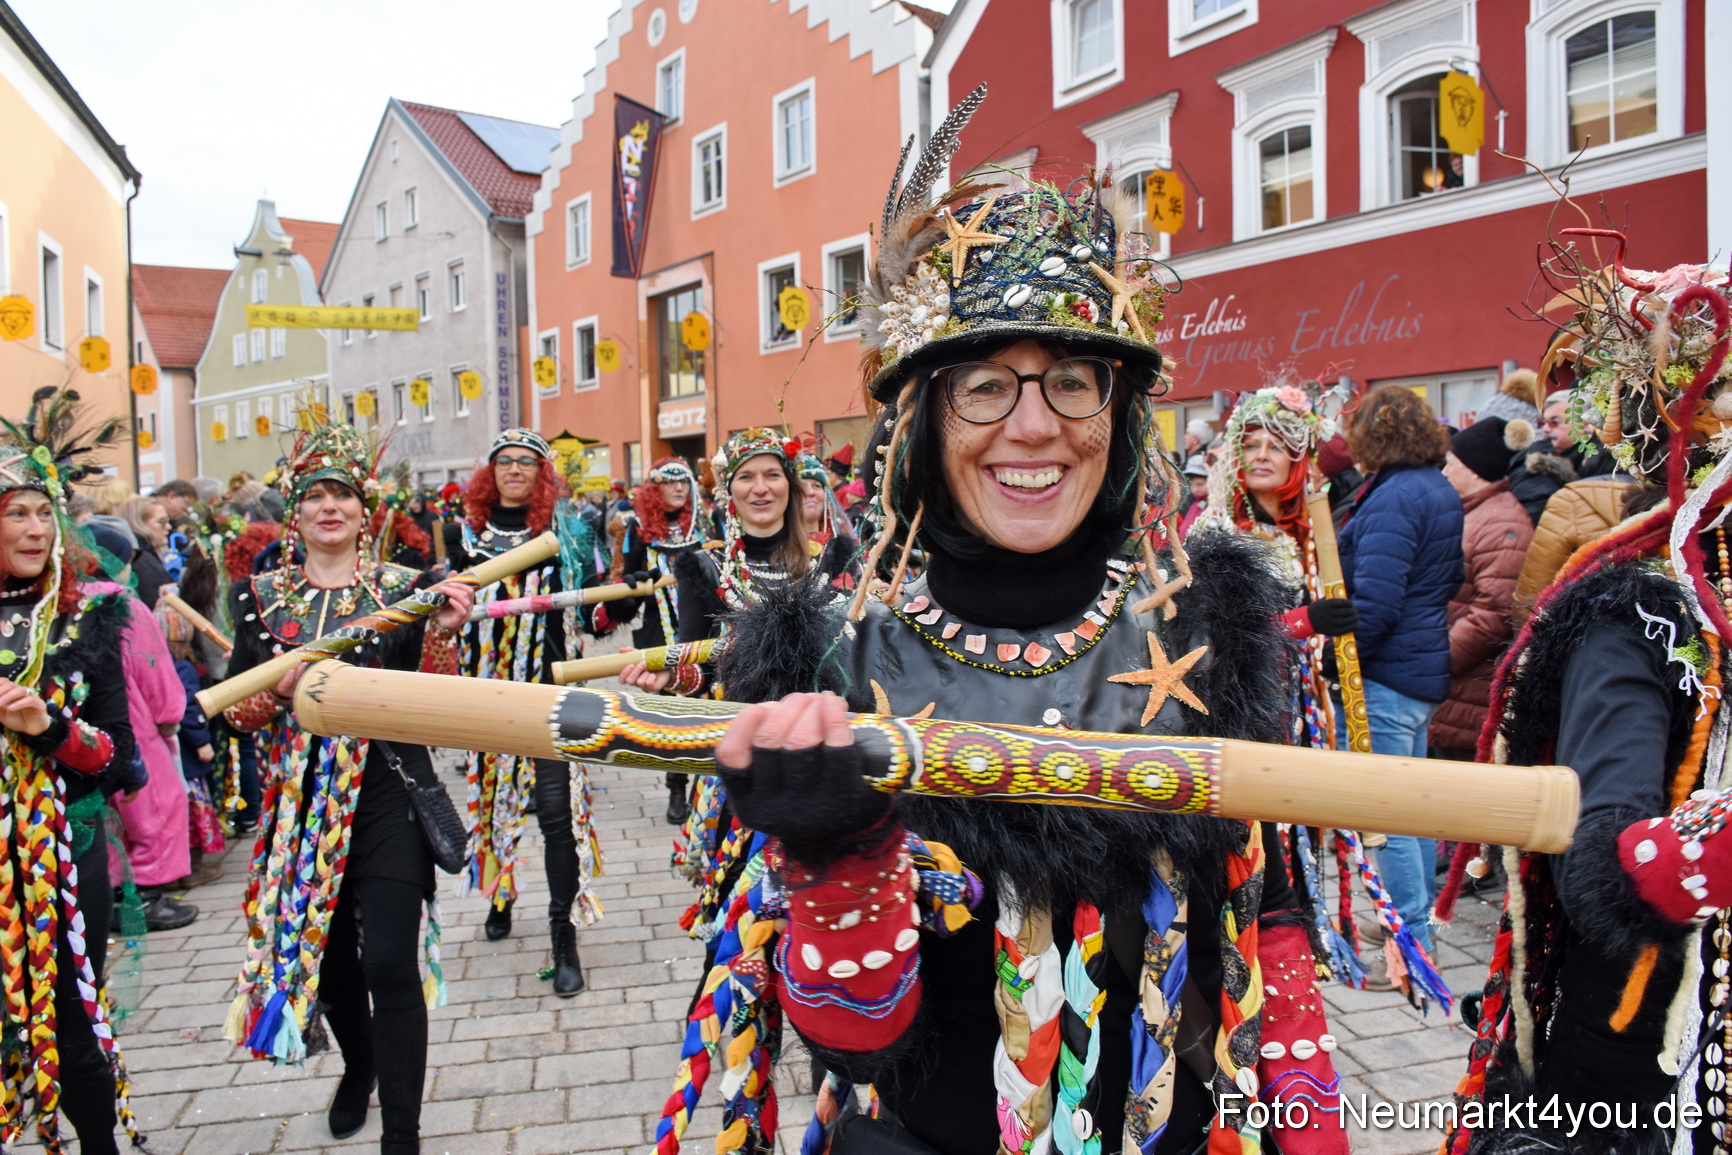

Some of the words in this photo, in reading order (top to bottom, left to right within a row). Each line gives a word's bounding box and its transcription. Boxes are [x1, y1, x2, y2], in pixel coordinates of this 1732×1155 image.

[496, 272, 508, 337] UHREN
[1180, 293, 1247, 340] Erlebnis
[1185, 332, 1276, 388] Genuss
[1291, 274, 1424, 355] Erlebnis
